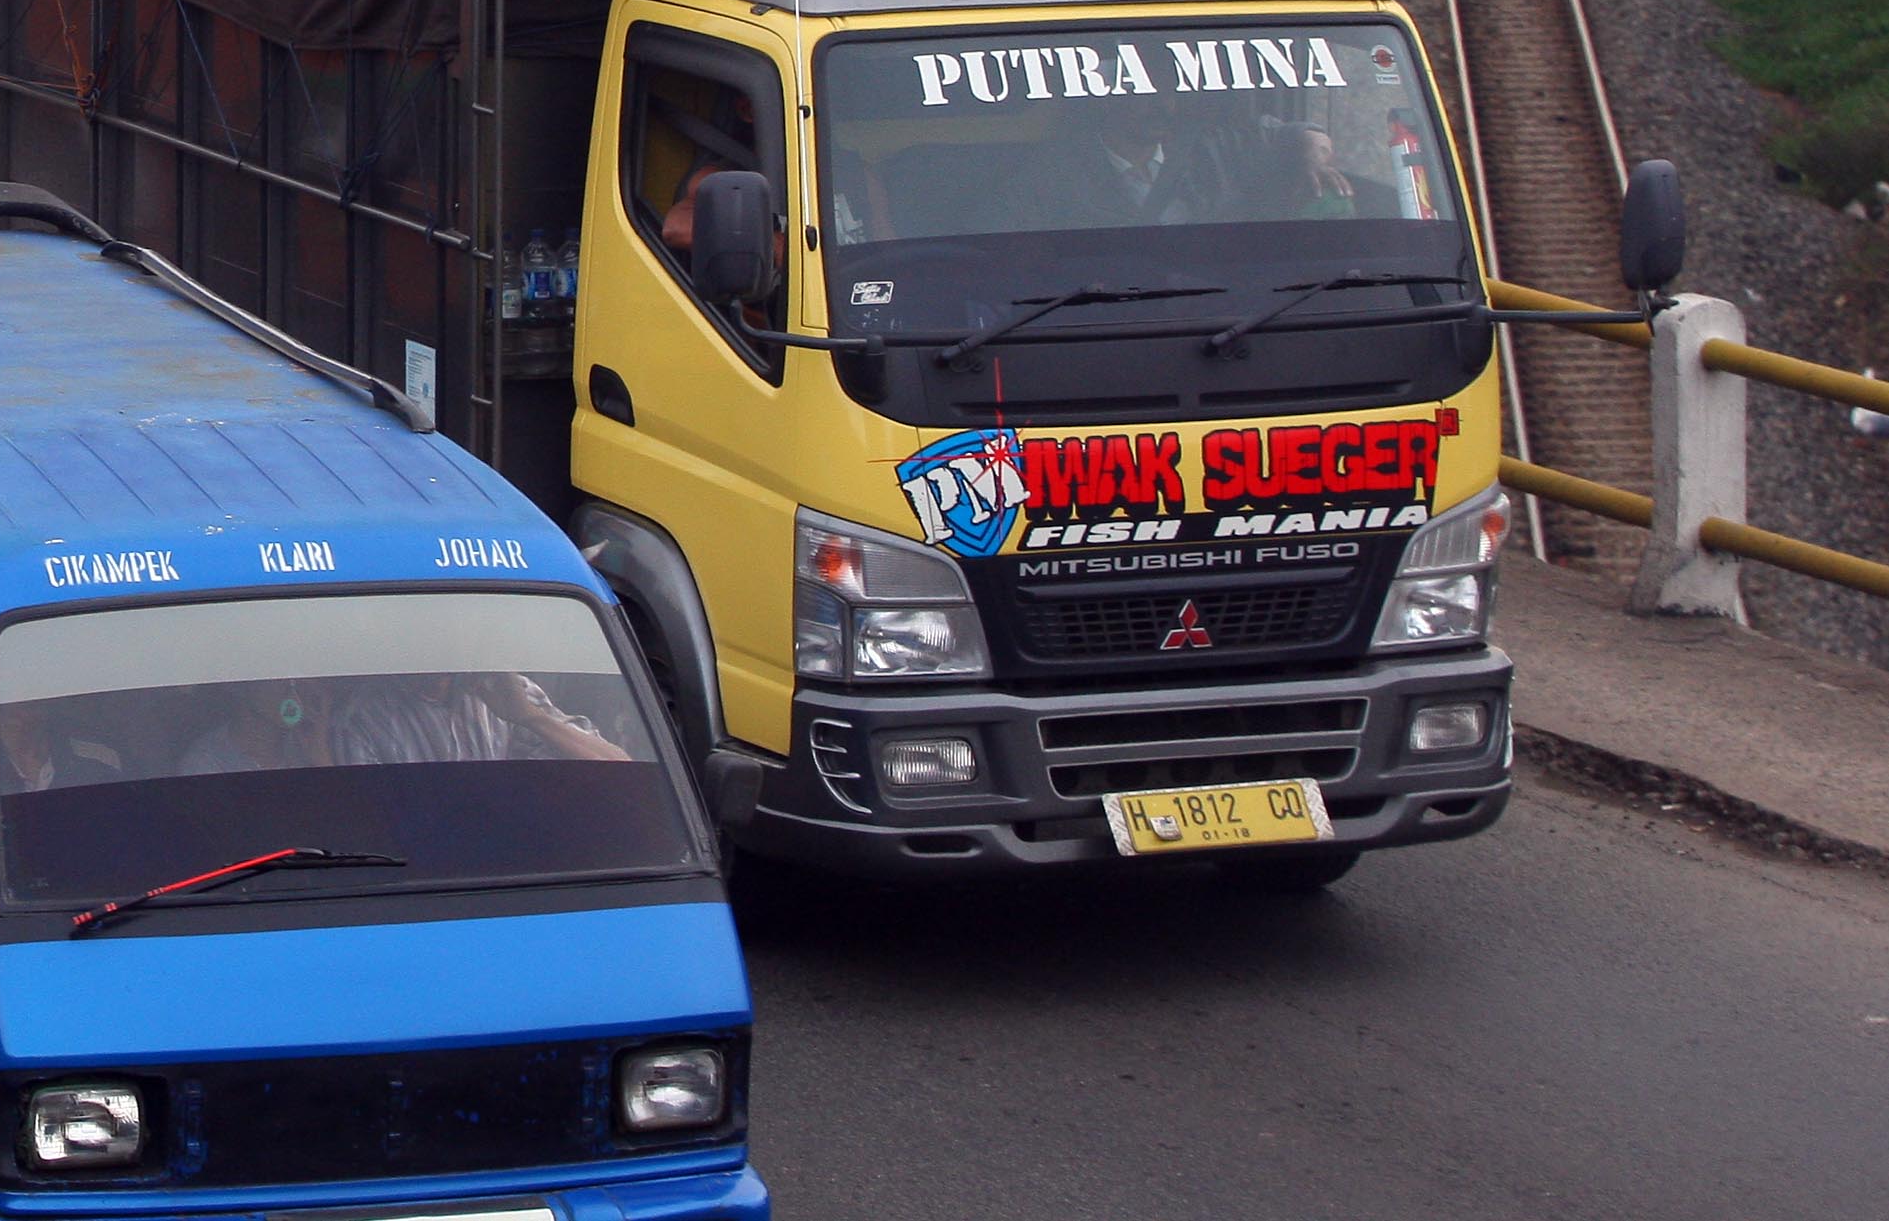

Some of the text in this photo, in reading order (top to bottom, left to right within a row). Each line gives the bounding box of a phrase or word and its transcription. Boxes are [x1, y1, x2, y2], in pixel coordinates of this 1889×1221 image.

[912, 37, 1348, 107] PUTRA MINA
[1202, 418, 1442, 505] SUEGER
[1025, 504, 1431, 548] FISH MANIA
[44, 538, 529, 588] CIKAMPEK KLARI JOHAR
[1018, 542, 1360, 578] MITSUBISHI FUSO
[1126, 799, 1151, 831] H
[1173, 792, 1242, 827] 1812
